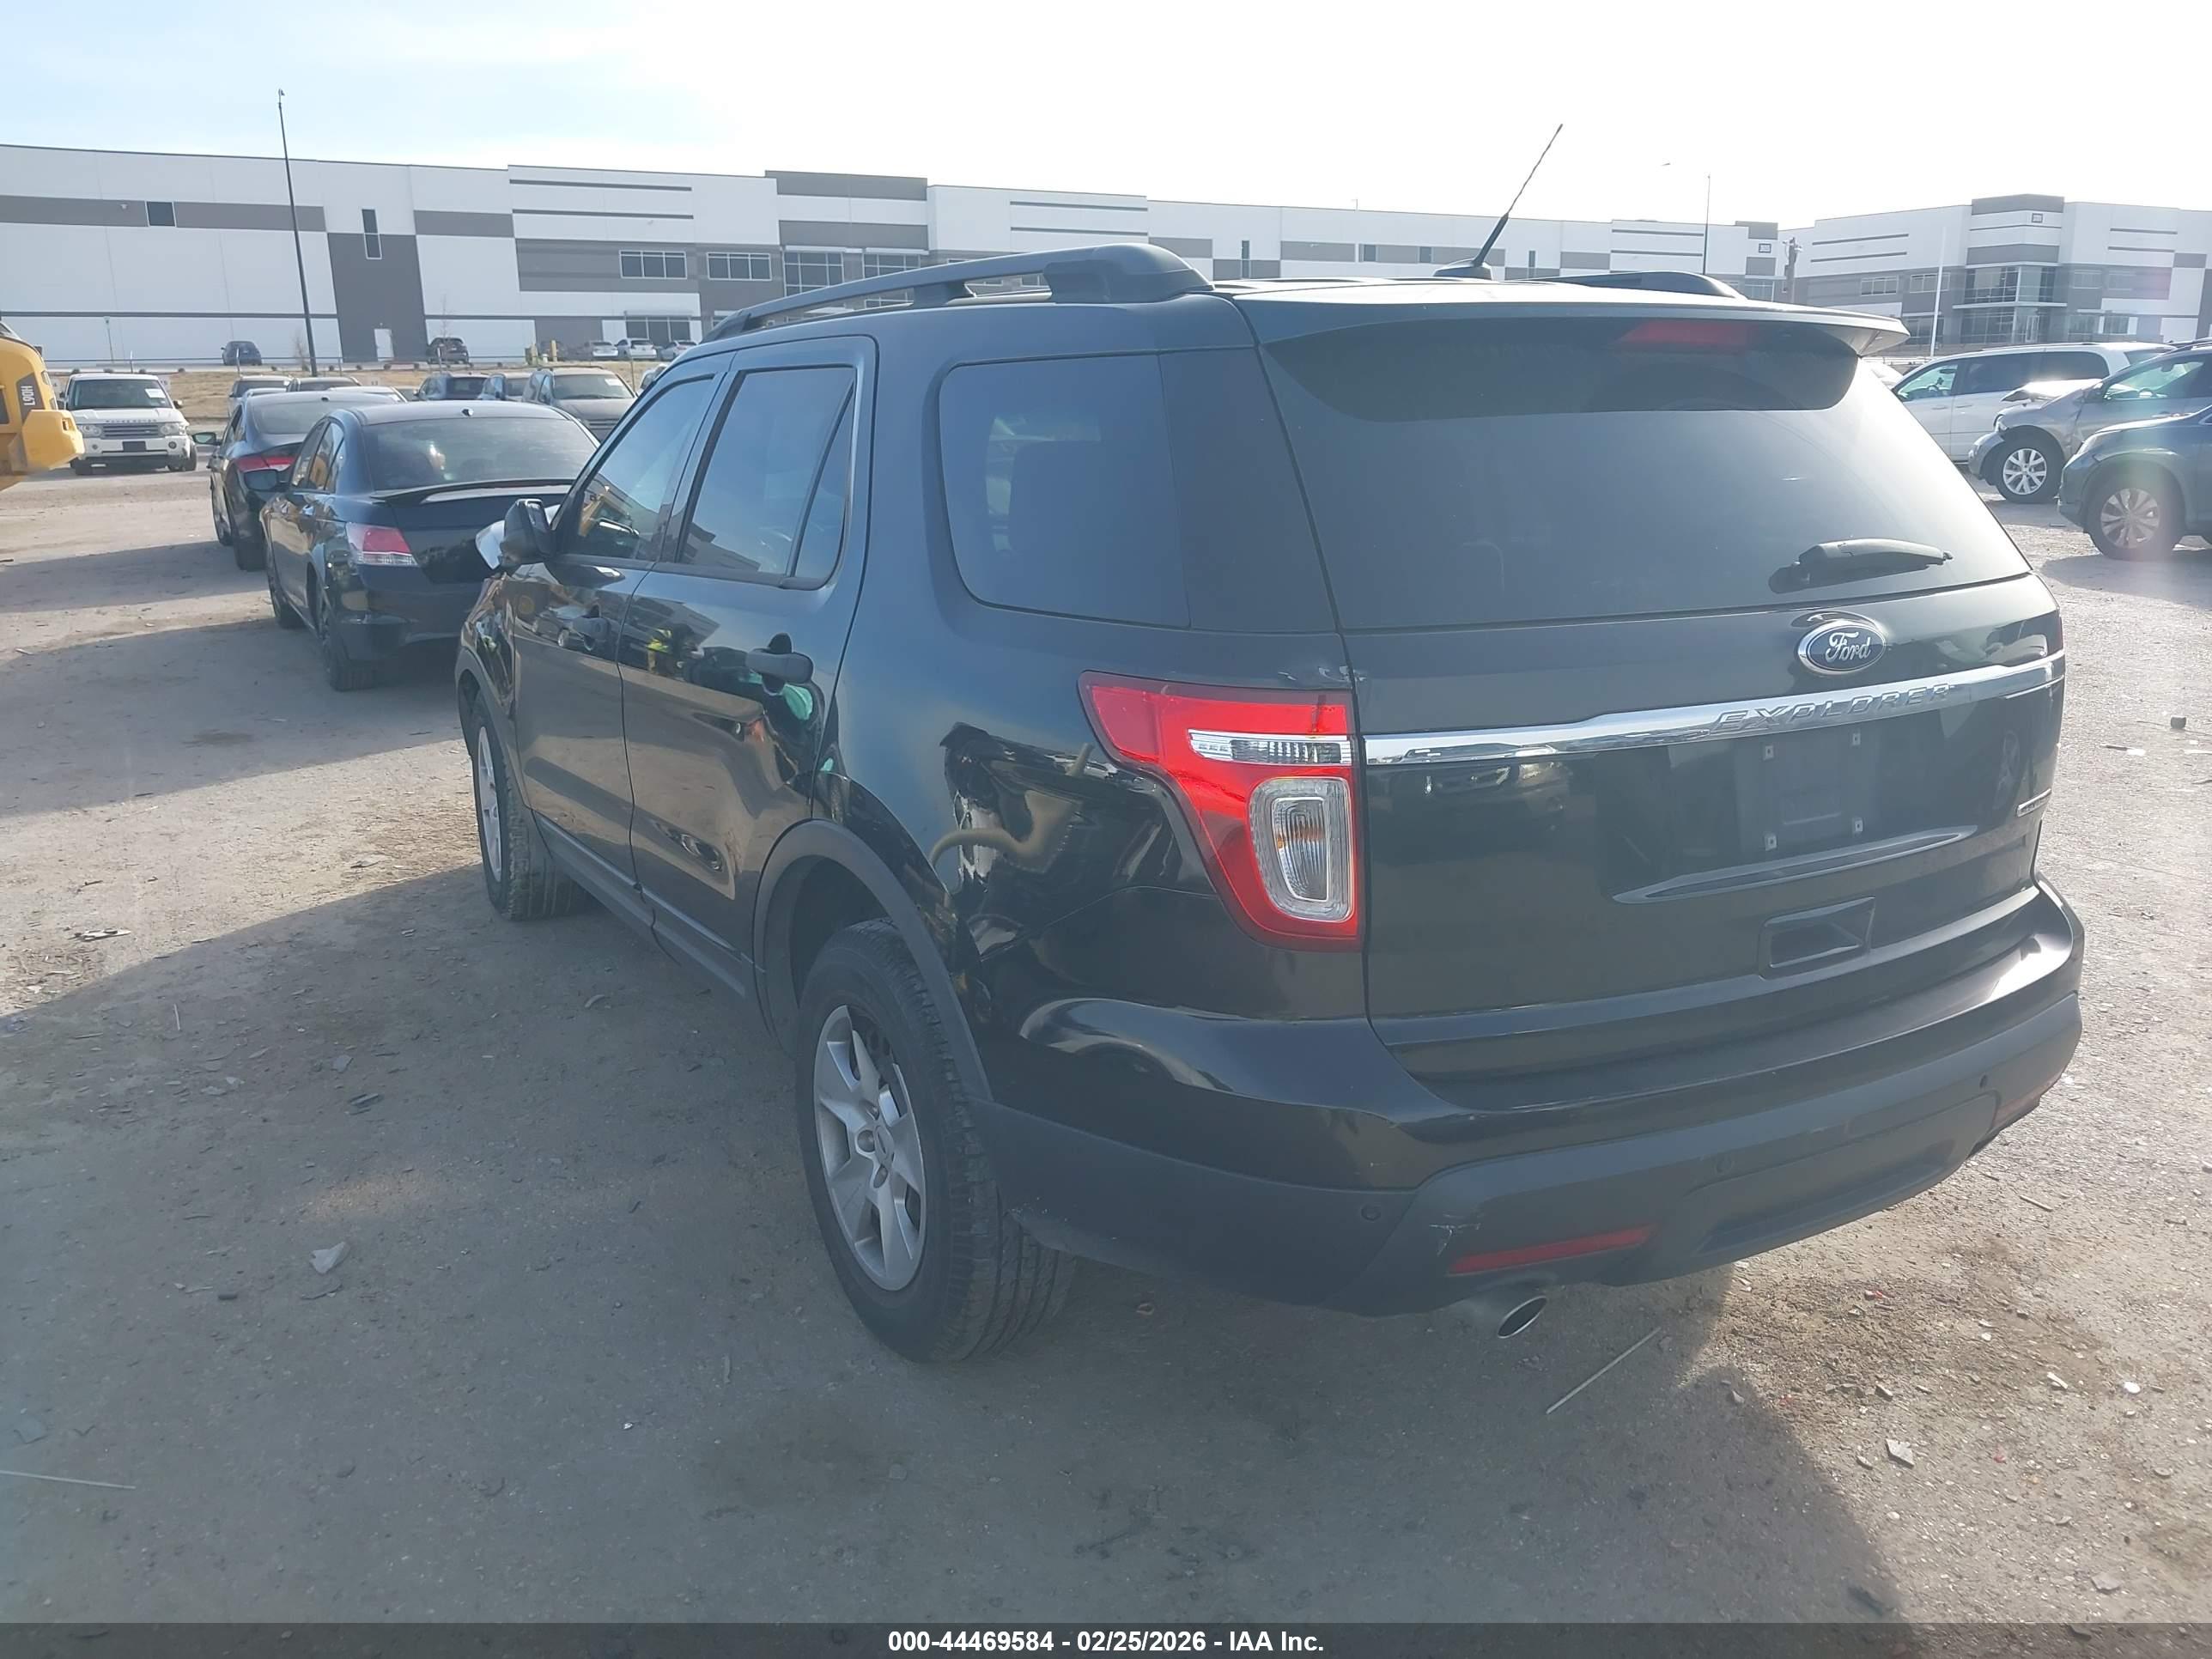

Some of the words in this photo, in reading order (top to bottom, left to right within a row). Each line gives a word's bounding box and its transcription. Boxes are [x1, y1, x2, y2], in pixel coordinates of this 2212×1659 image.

[21, 386, 35, 405] L90H
[1825, 631, 1871, 663] Ford
[1714, 683, 1954, 730] EXPLORER
